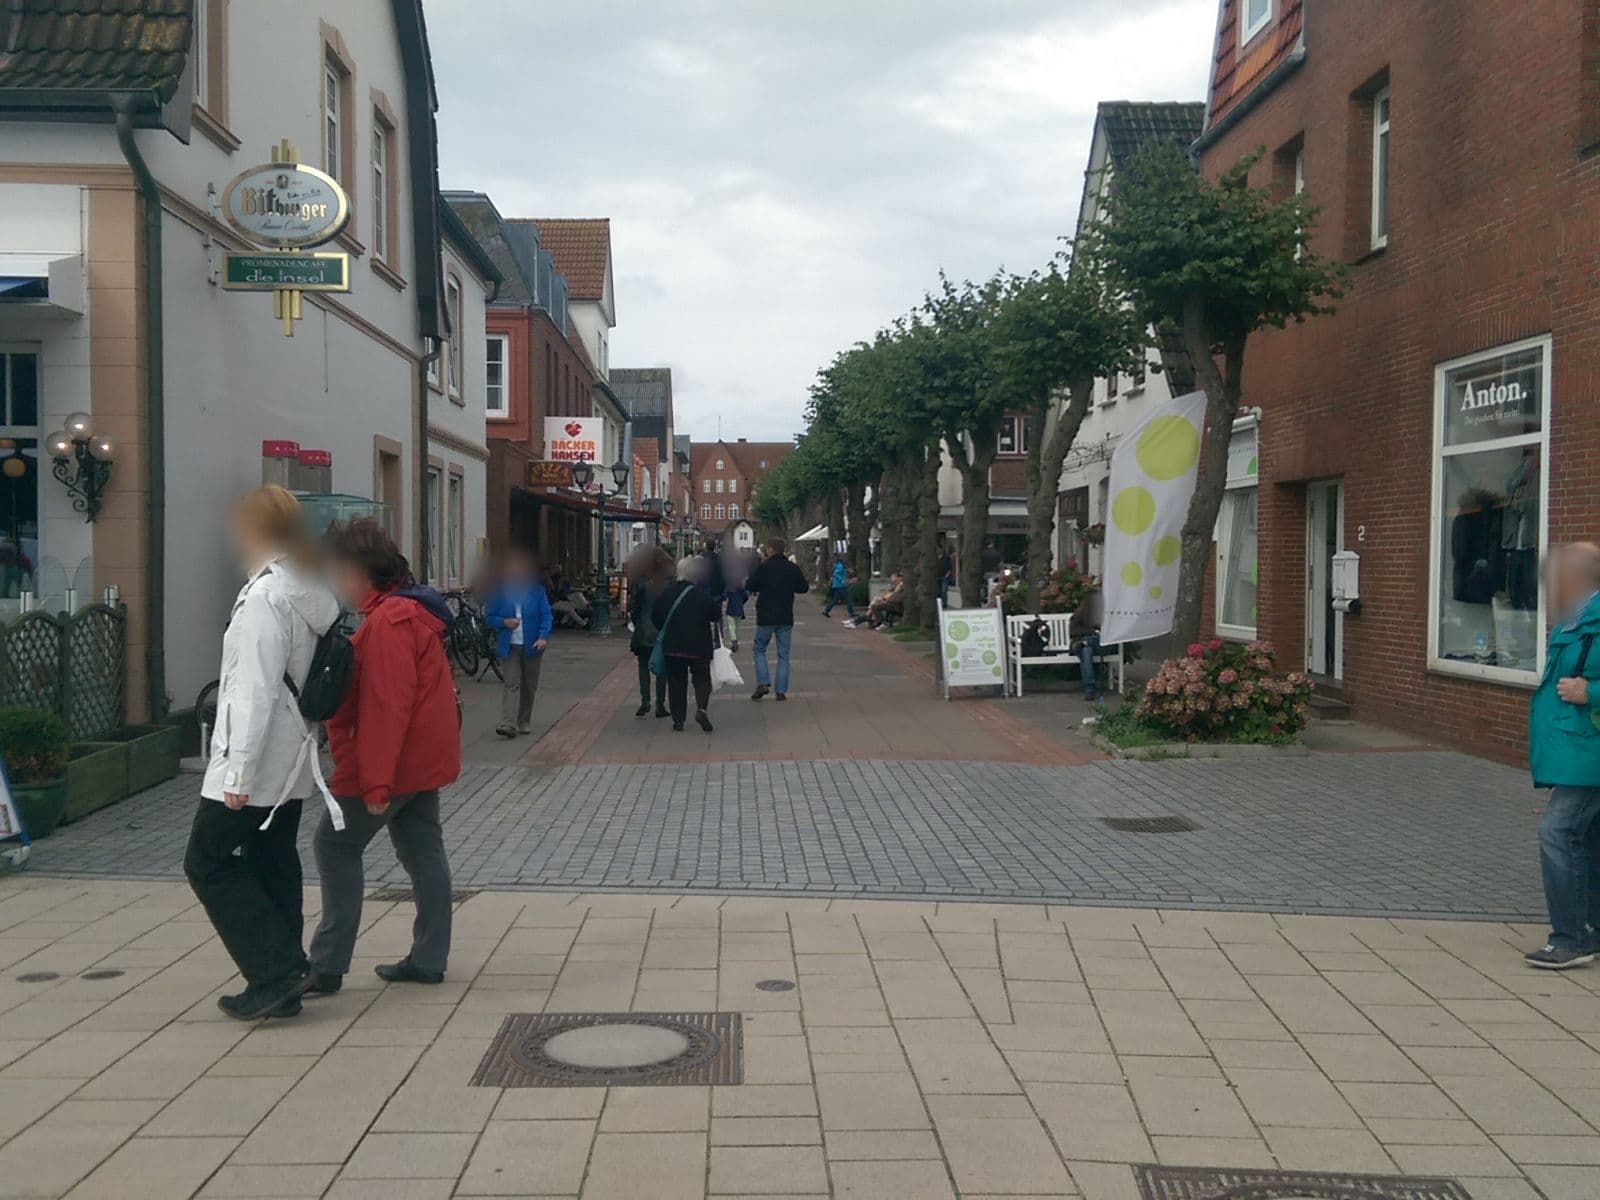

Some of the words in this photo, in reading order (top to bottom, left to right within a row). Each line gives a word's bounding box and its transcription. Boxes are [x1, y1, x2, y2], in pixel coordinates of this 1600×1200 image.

[242, 187, 327, 221] Bitburger
[246, 269, 273, 283] die
[279, 269, 325, 283] insel
[1460, 381, 1528, 412] Anton.
[551, 438, 595, 450] BÄCKER
[551, 451, 595, 461] HANSEN
[1358, 525, 1365, 541] 2
